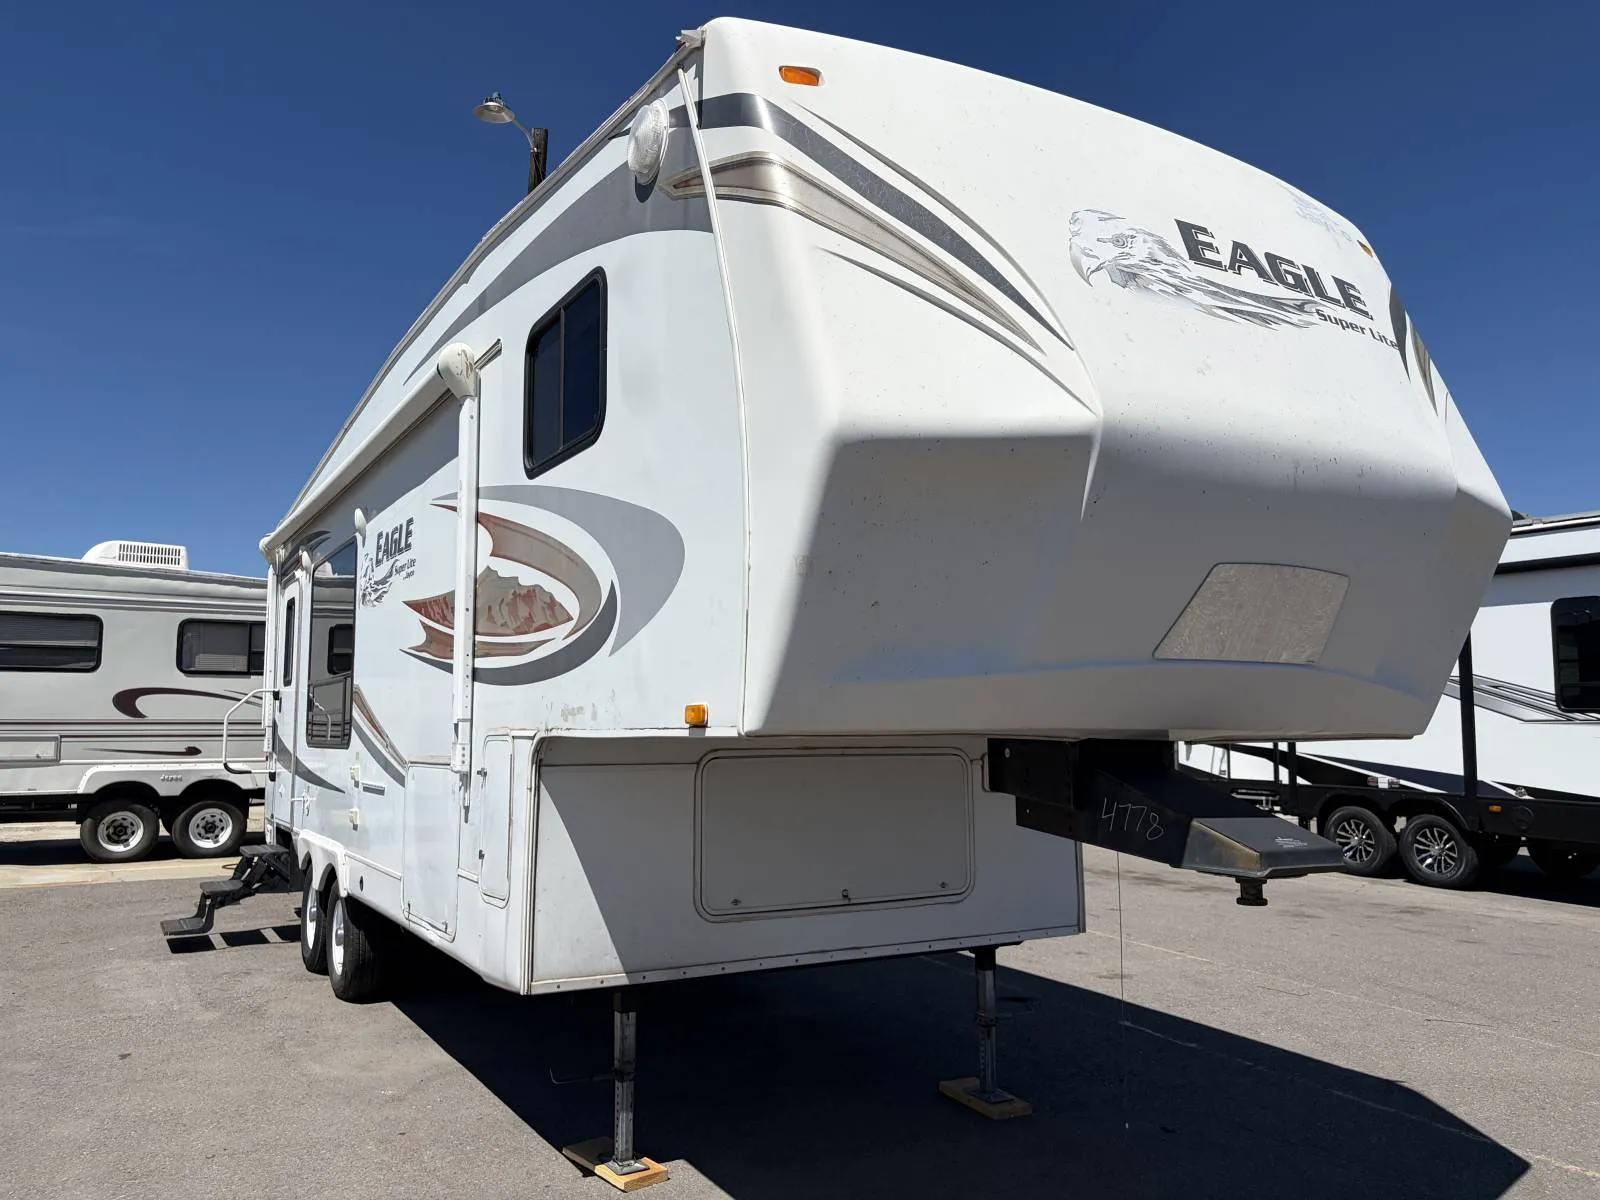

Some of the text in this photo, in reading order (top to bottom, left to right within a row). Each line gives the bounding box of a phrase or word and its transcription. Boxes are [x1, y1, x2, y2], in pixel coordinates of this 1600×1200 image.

[1174, 218, 1374, 321] EAGLE
[1315, 308, 1400, 351] Super Lite
[375, 516, 415, 568] EAGLE
[1101, 796, 1165, 841] 4778
